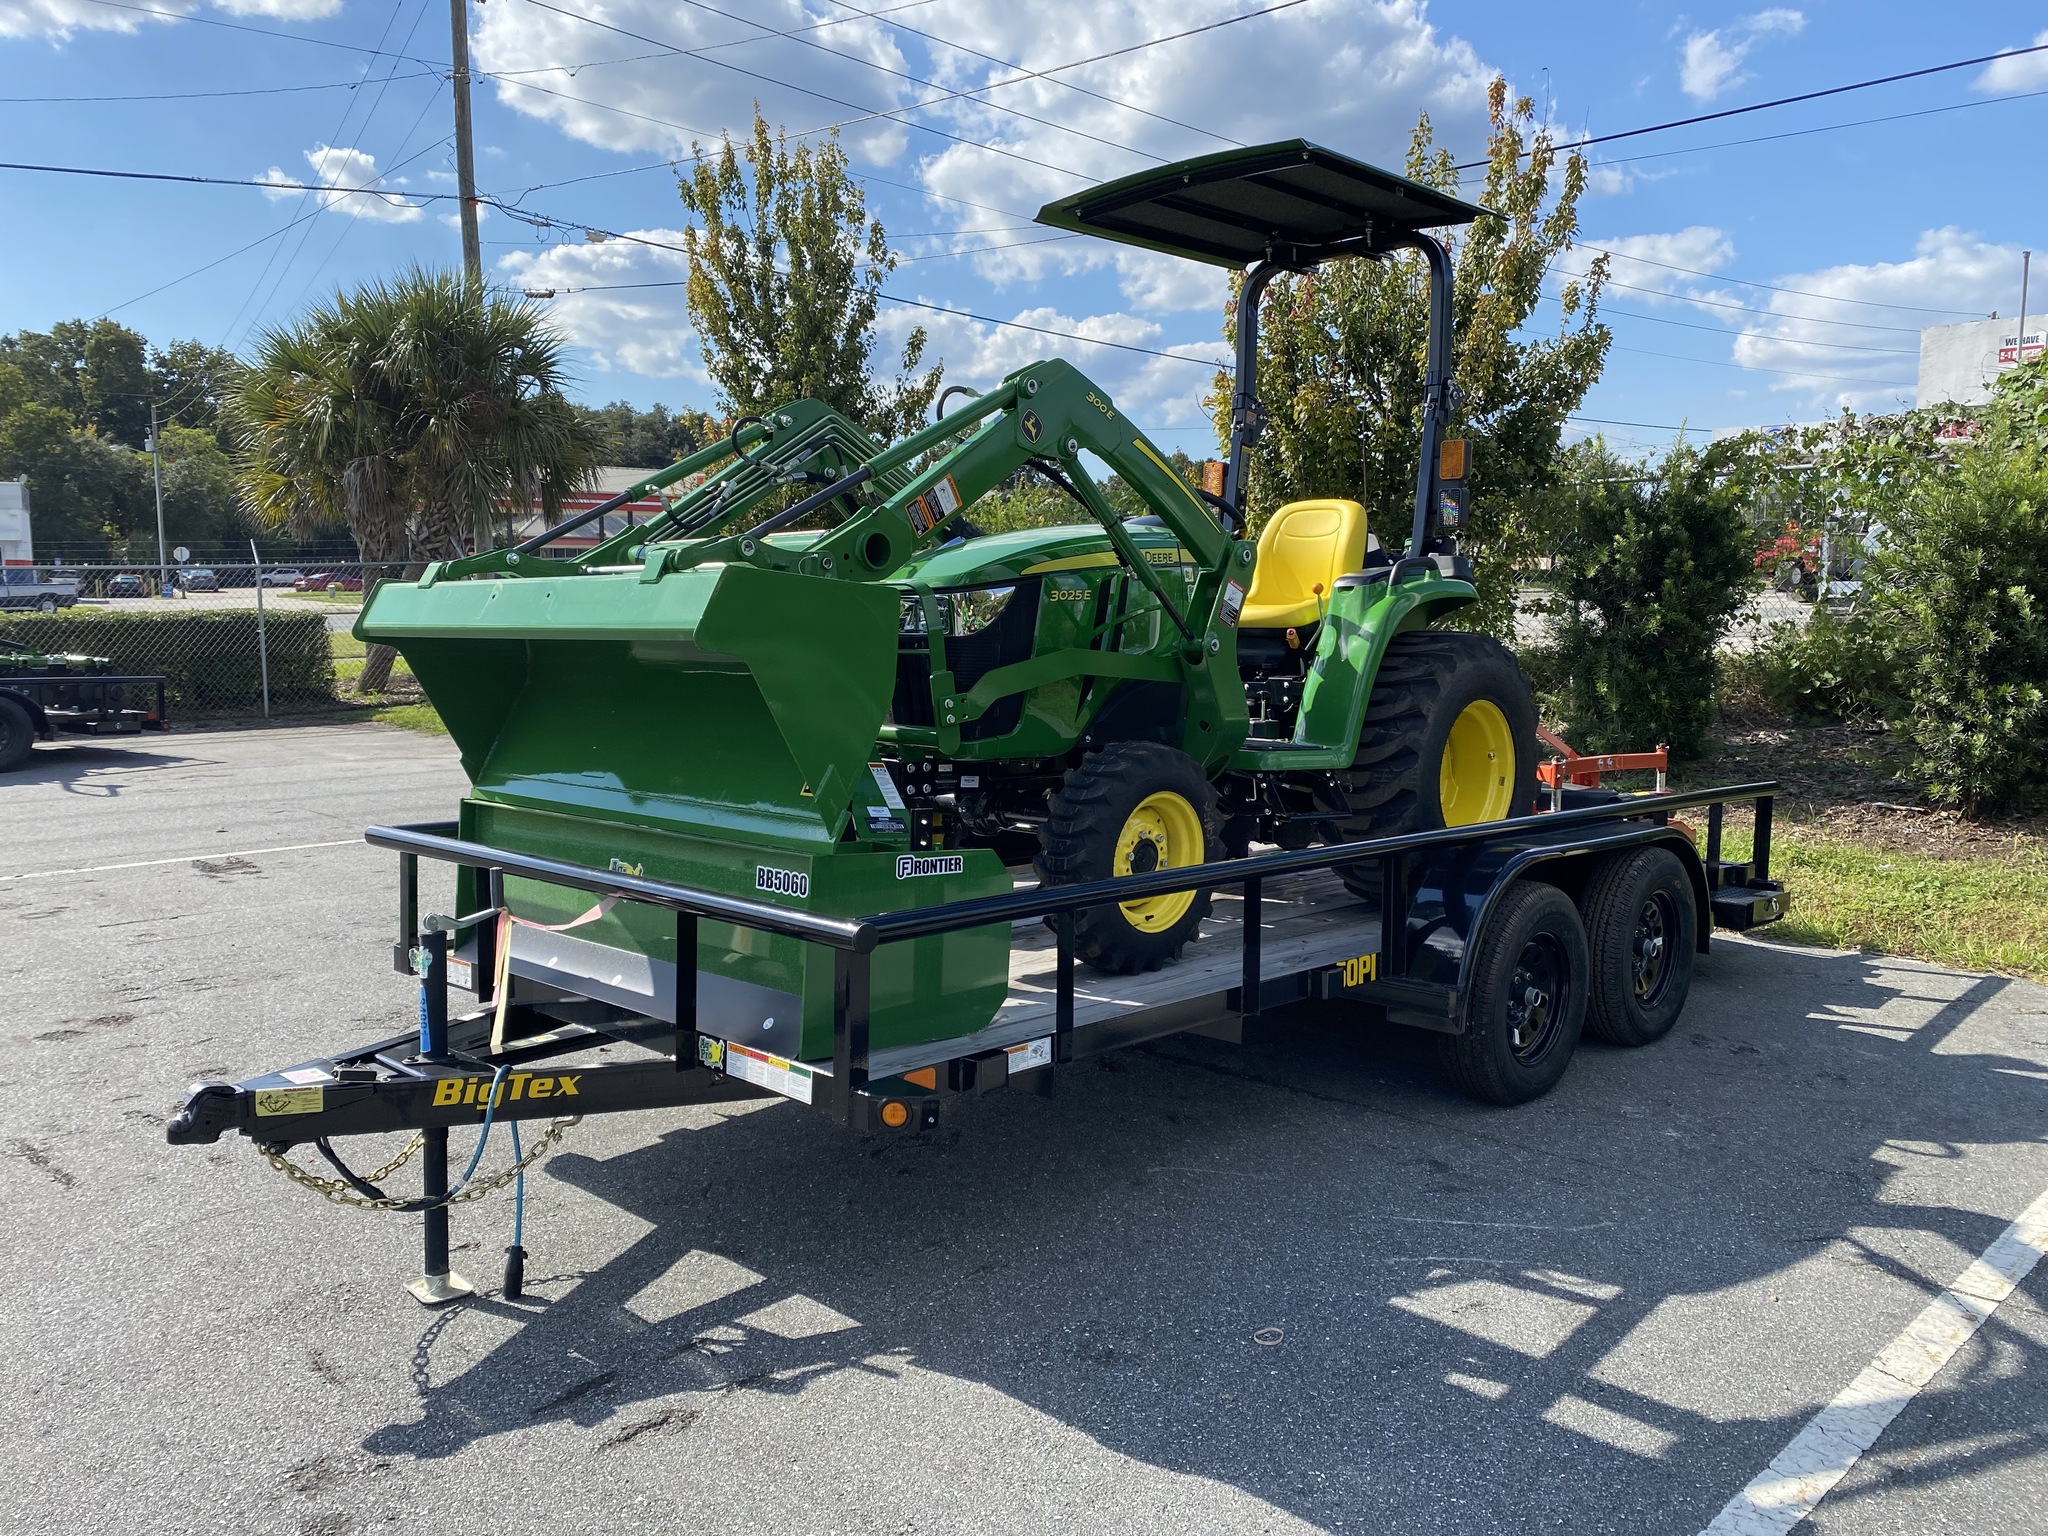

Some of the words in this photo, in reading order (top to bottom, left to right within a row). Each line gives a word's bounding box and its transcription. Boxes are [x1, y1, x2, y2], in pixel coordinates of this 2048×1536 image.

[2005, 337, 2018, 346] WE
[2022, 335, 2040, 345] HAVE
[1145, 551, 1174, 563] DEERE
[1050, 589, 1092, 602] 3025E
[897, 856, 963, 879] FRONTIER
[757, 866, 808, 897] BB5060
